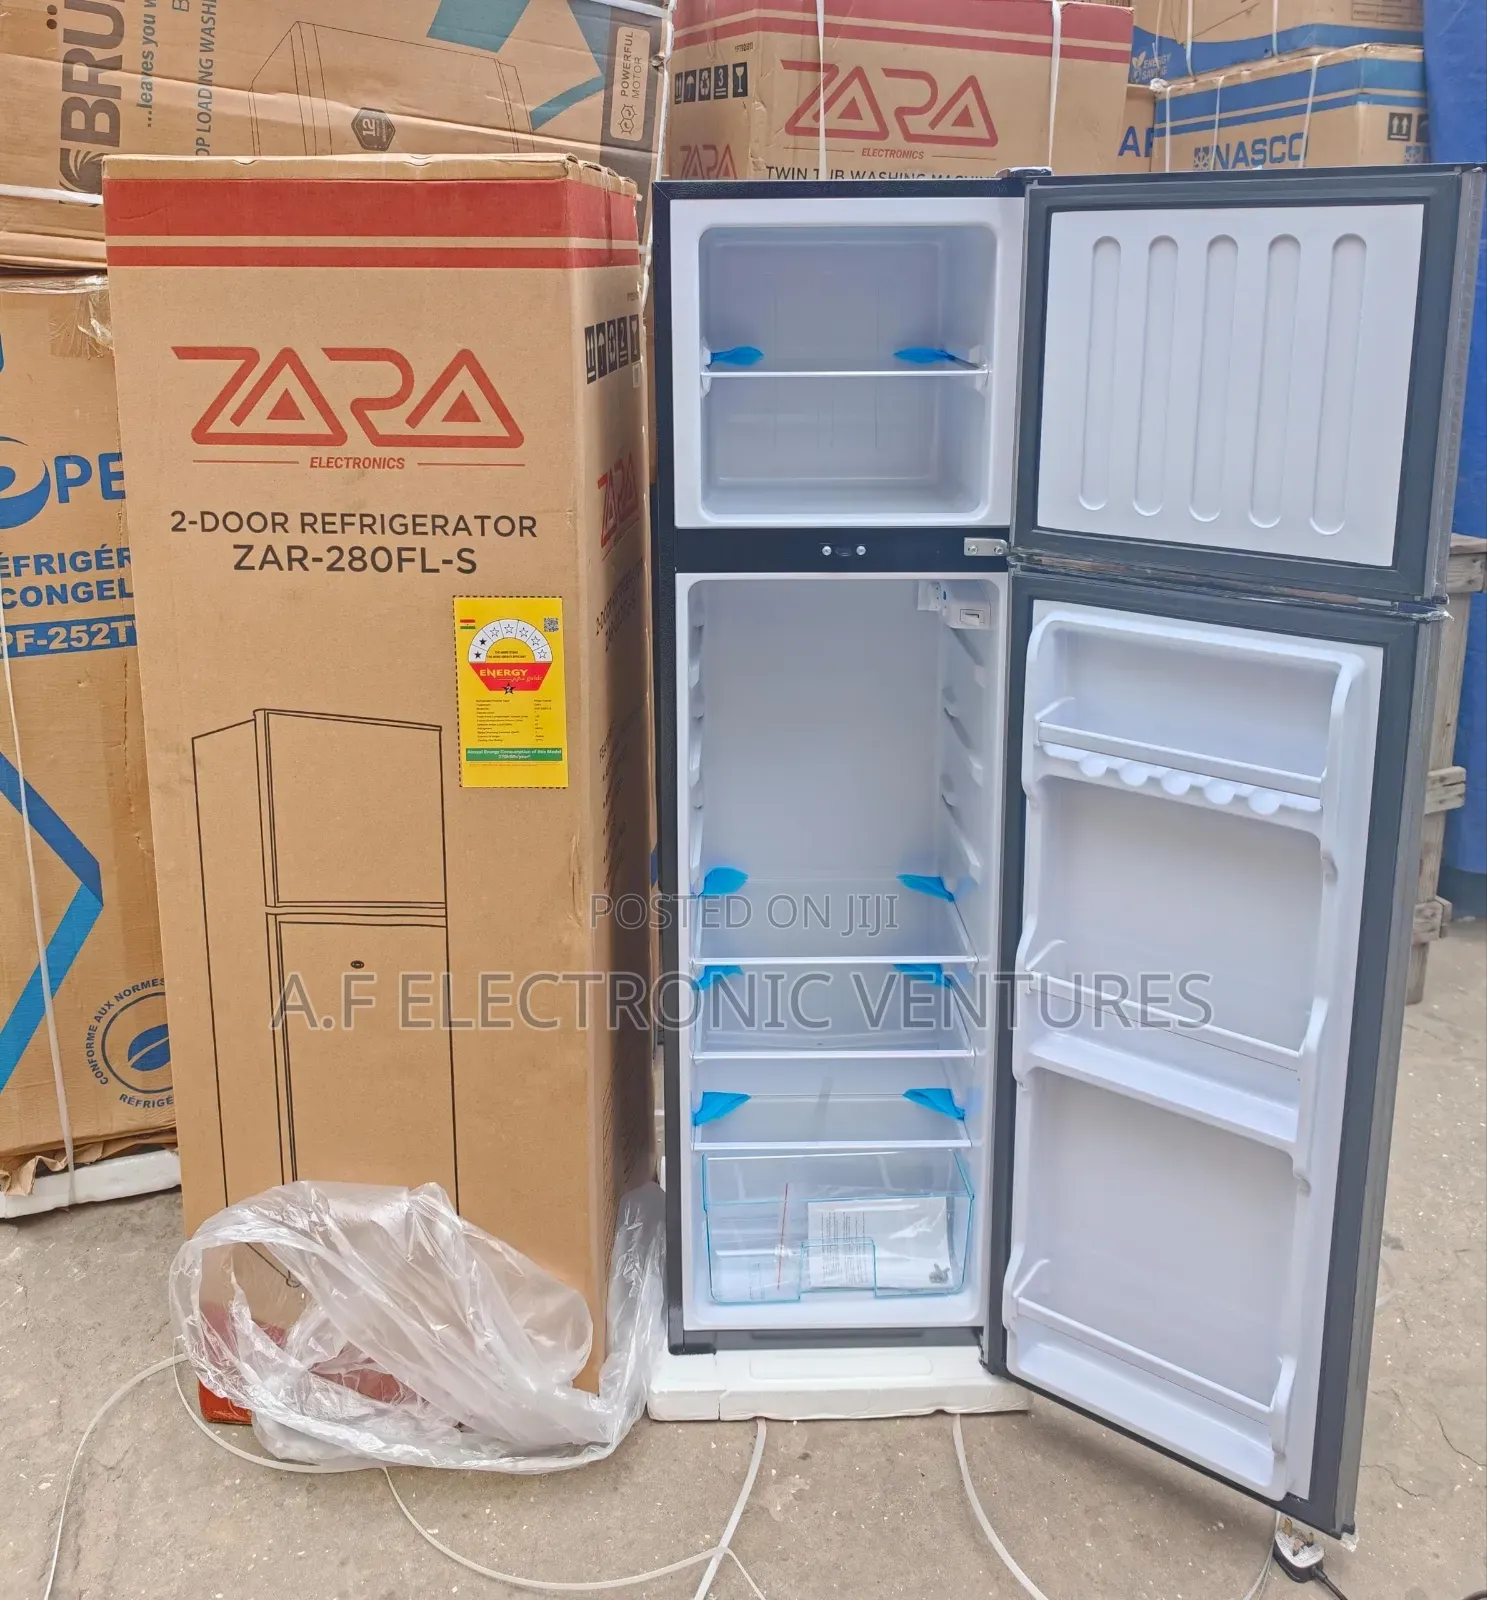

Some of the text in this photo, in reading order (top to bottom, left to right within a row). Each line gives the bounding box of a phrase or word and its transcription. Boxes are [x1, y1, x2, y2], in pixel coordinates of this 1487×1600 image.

[142, 14, 158, 47] you
[47, 0, 124, 147] BRÜ
[621, 32, 634, 98] POWERFUL
[632, 57, 642, 99] MOTOR
[196, 58, 214, 133] LOADING
[780, 59, 999, 147] ZARA
[362, 118, 376, 136] 12
[861, 147, 925, 160] ELECTRONICS
[1212, 132, 1309, 170] NASCO
[766, 166, 808, 180] TWIN
[171, 346, 525, 448] ZARA
[309, 456, 405, 470] ELECTRONICS
[170, 510, 538, 538] 2-DOOR REFRIGERATOR
[233, 544, 477, 574] ZAR-280FL-S
[0, 621, 136, 655] PF-252T
[480, 668, 529, 678] ENERGY
[94, 1000, 115, 1023] AUX
[86, 1024, 109, 1085] CONFORME
